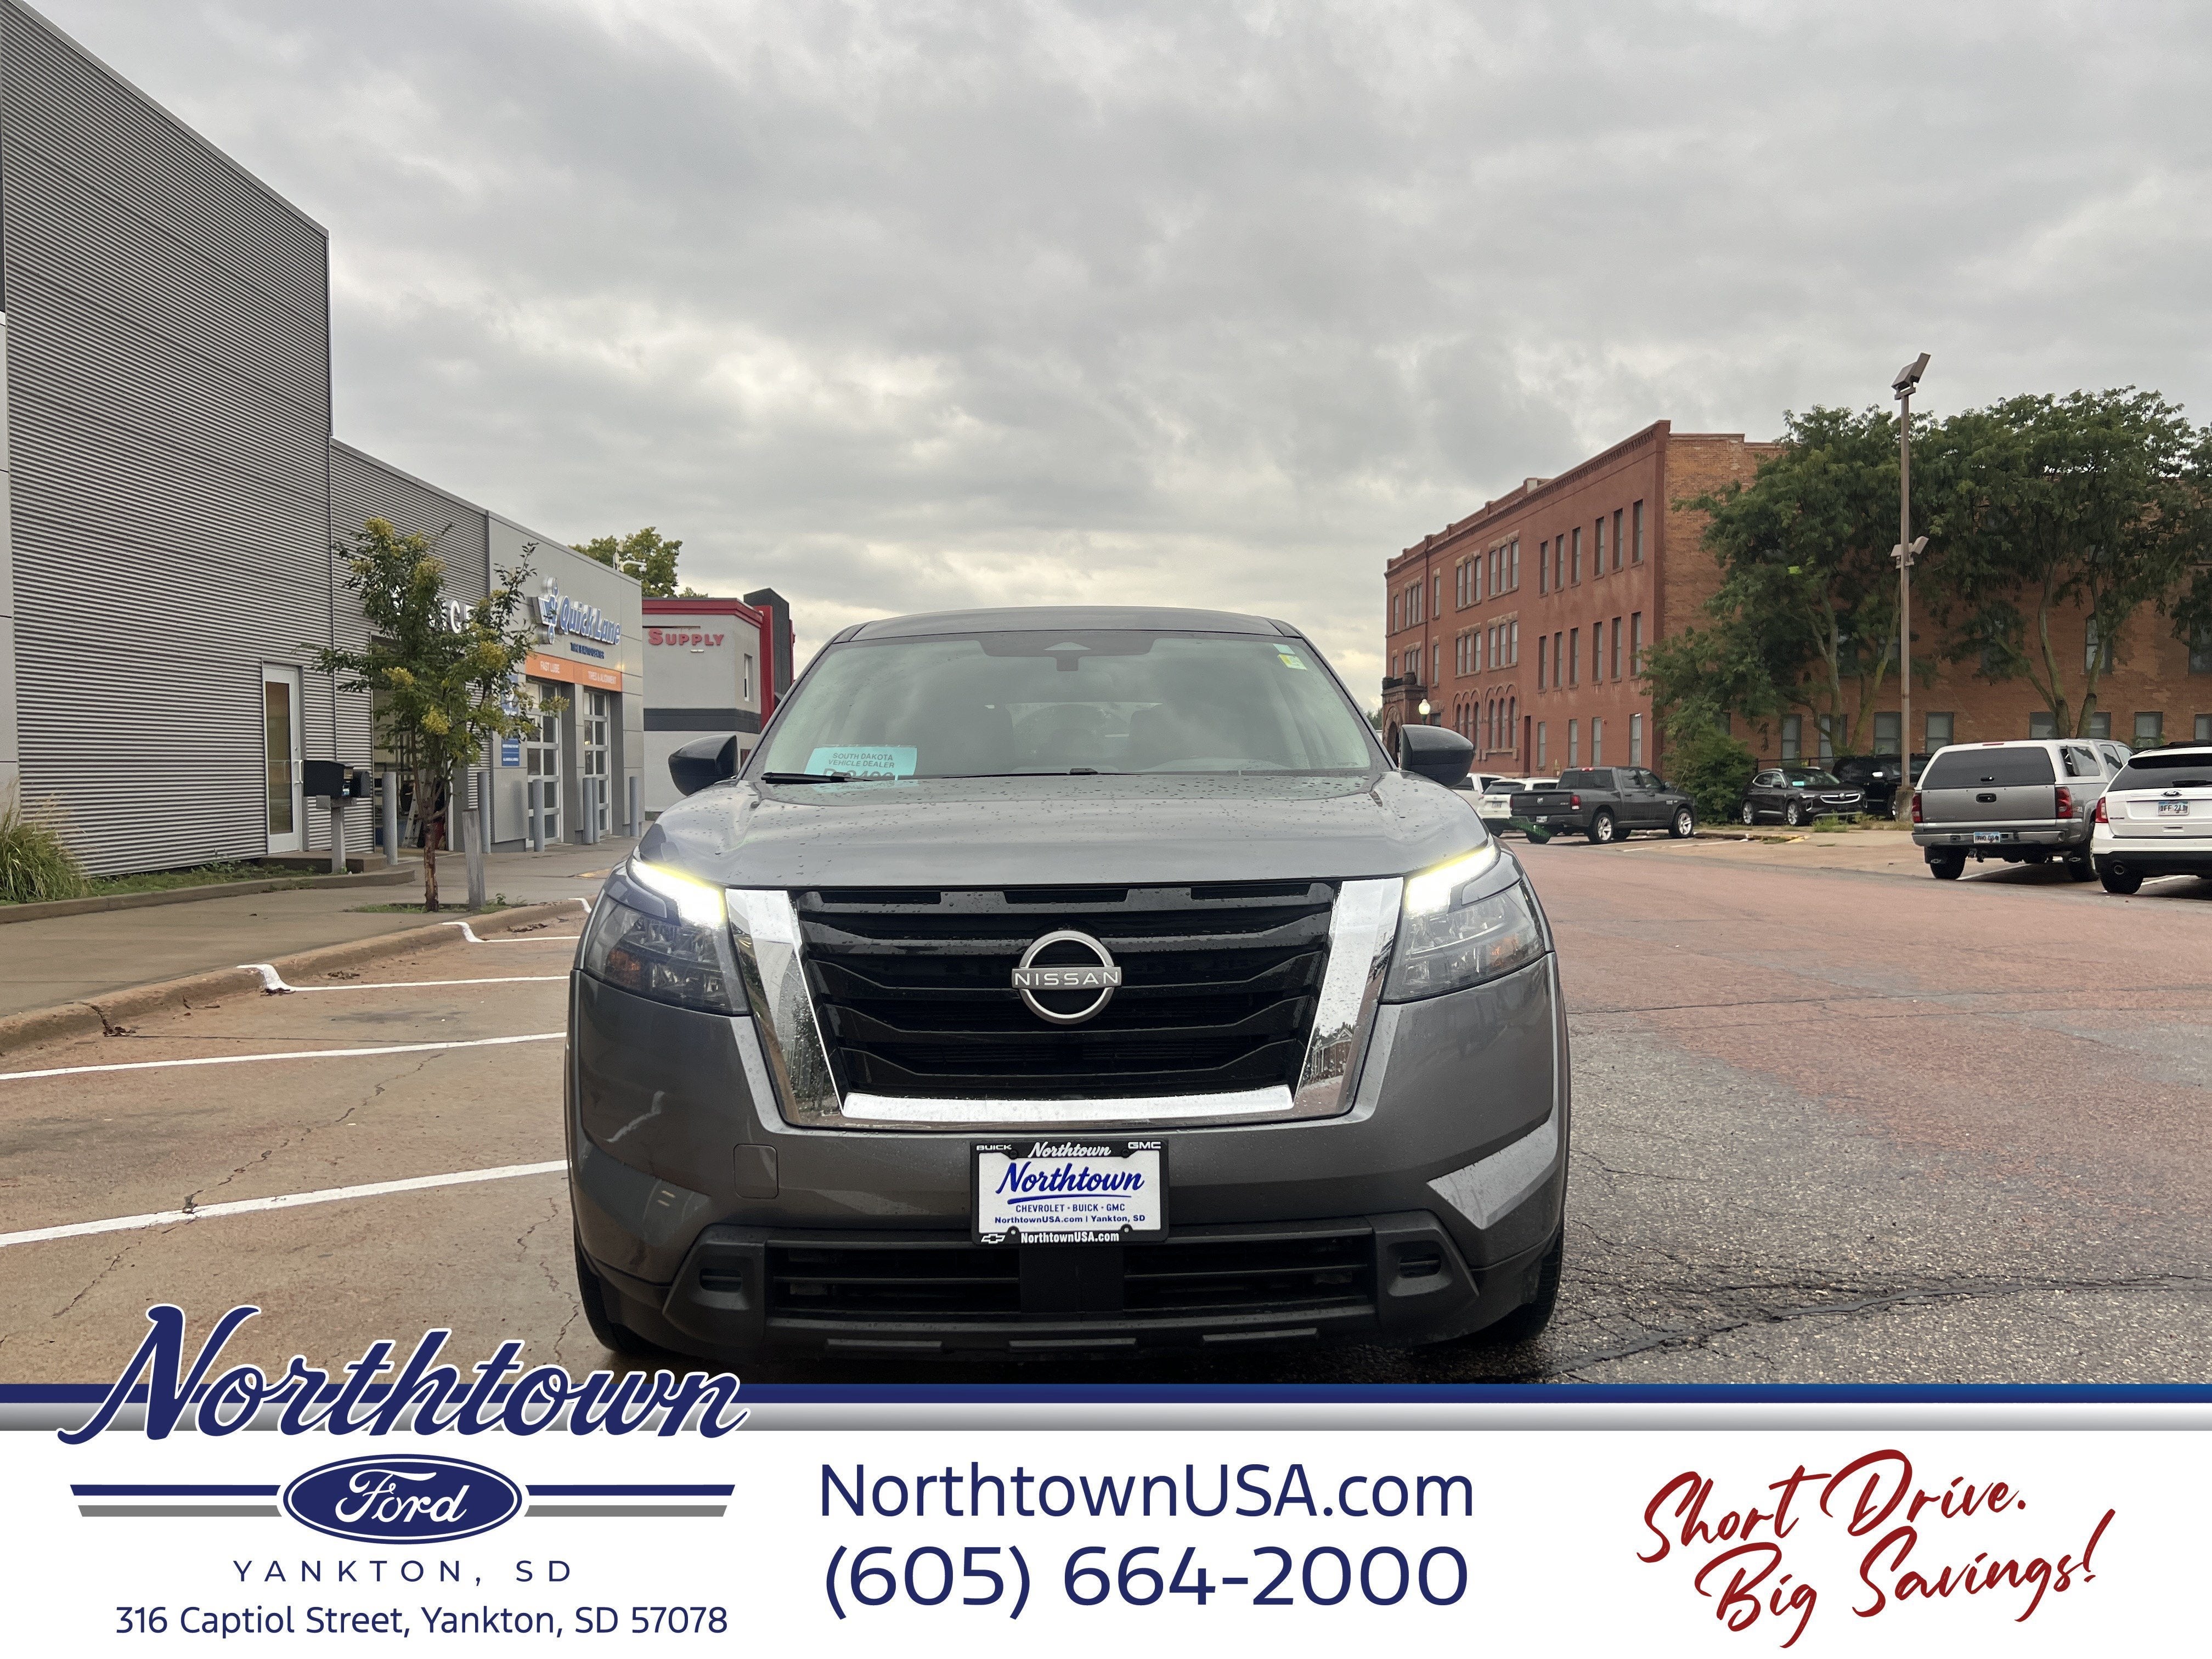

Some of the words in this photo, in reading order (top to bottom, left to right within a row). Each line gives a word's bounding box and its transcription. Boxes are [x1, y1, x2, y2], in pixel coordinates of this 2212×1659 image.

[560, 595, 594, 637] Quick
[594, 608, 621, 645] Lane
[648, 628, 724, 646] SUPPLY
[860, 753, 893, 761] DAKOTA
[1014, 970, 1119, 986] NISSAN
[1027, 1141, 1111, 1158] Northtown
[1127, 1141, 1161, 1149] GMC
[995, 1161, 1145, 1194] Northtown
[1015, 1204, 1065, 1213] CHEVROLET
[1073, 1204, 1098, 1212] BUICK
[1106, 1203, 1125, 1211] GMC
[995, 1216, 1083, 1224] NorthtownUSA.com
[1091, 1215, 1130, 1224] Yankton,
[1020, 1232, 1119, 1244] NorthtownUSA.com
